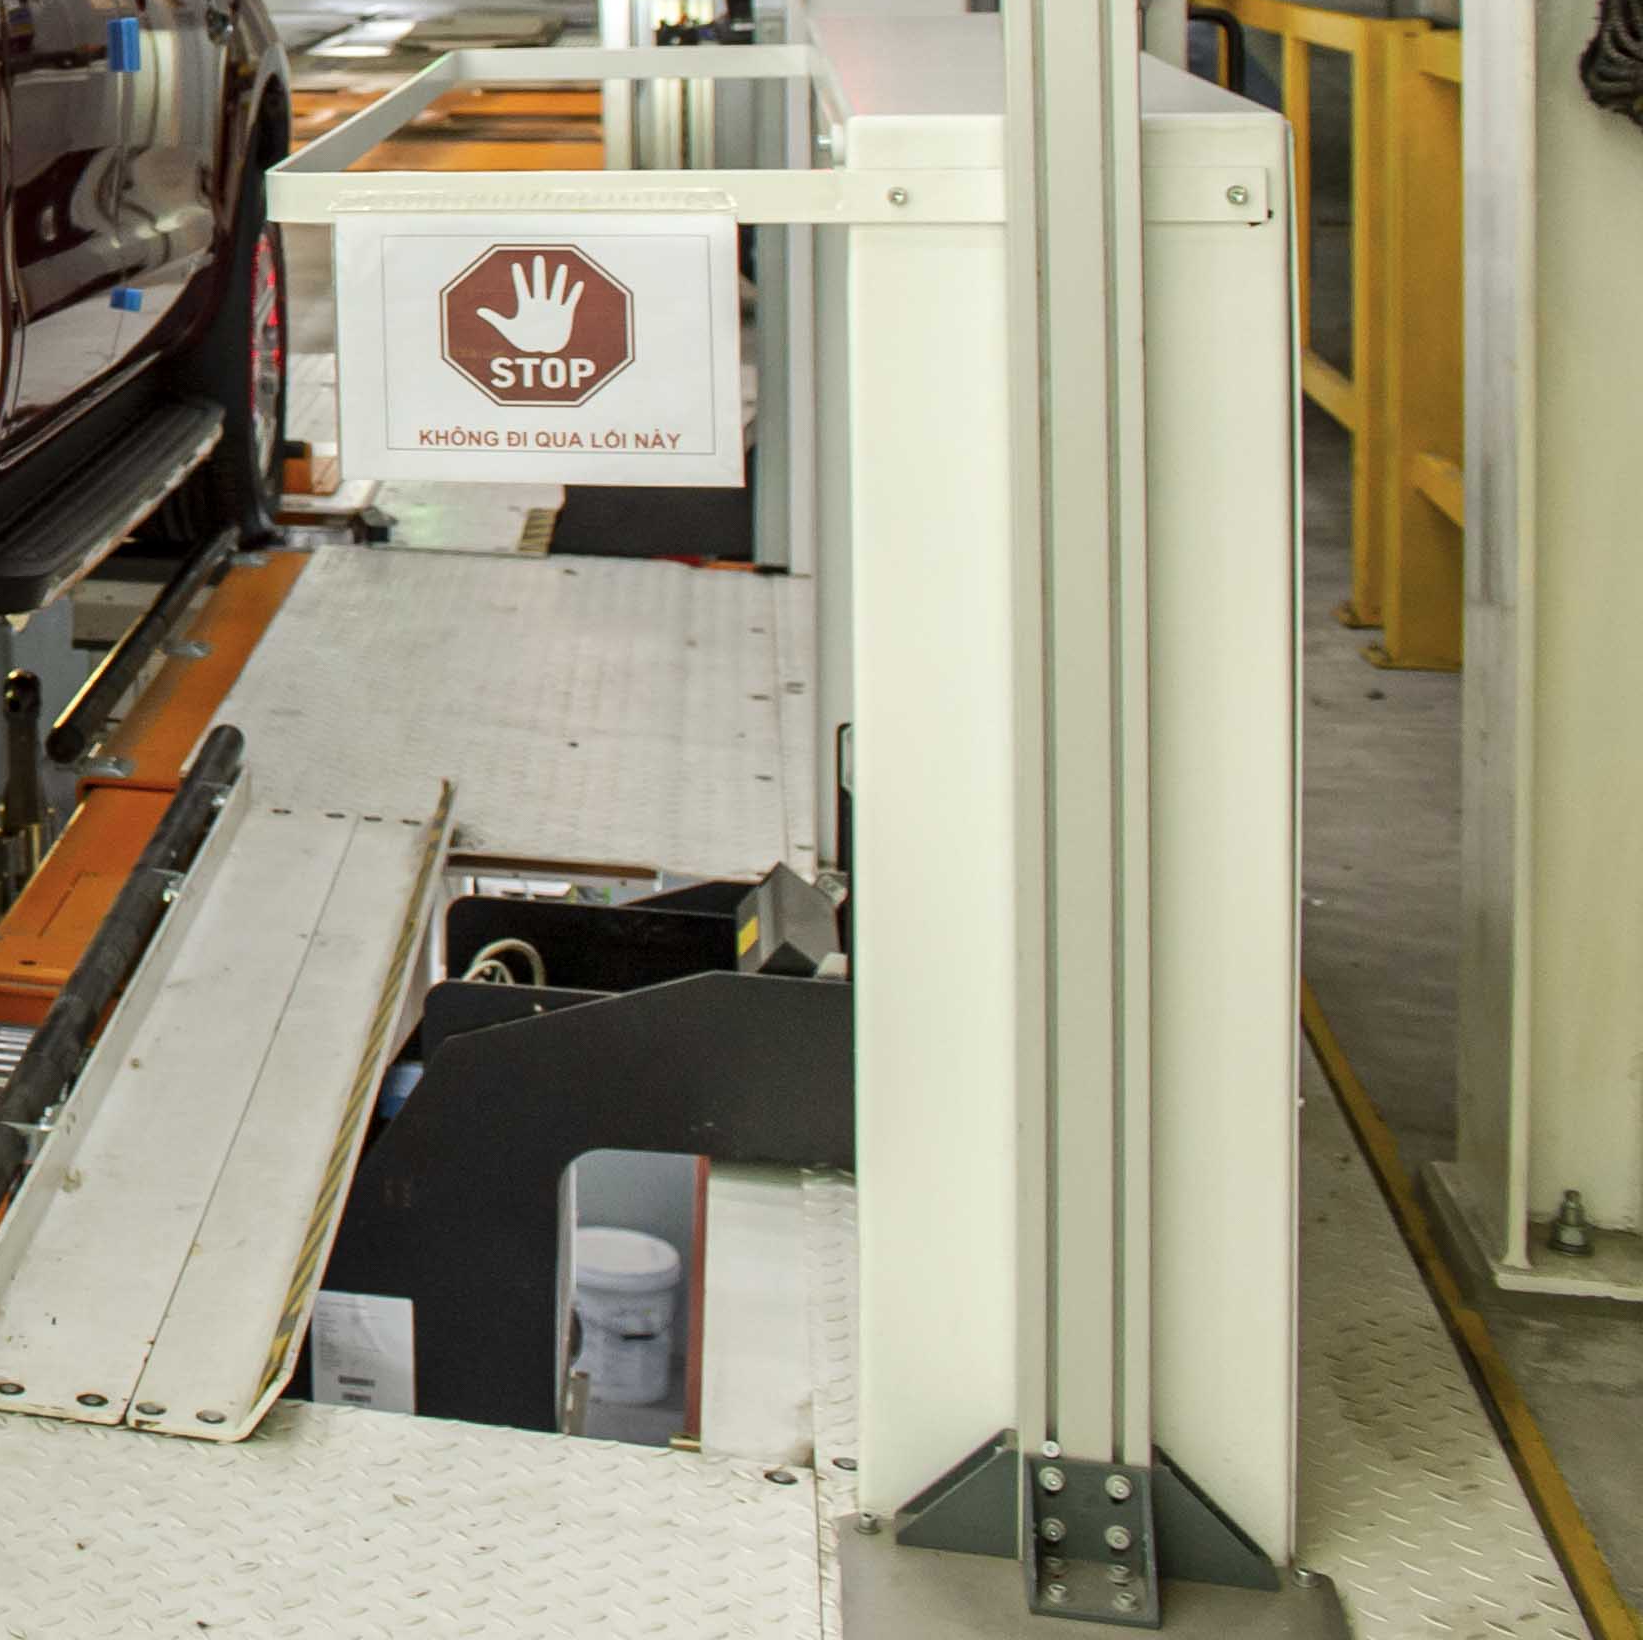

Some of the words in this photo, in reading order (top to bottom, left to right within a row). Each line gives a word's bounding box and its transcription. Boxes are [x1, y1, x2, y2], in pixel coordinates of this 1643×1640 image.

[489, 356, 596, 389] STOP
[418, 425, 500, 447] KHÔNG
[534, 431, 584, 449] QUA
